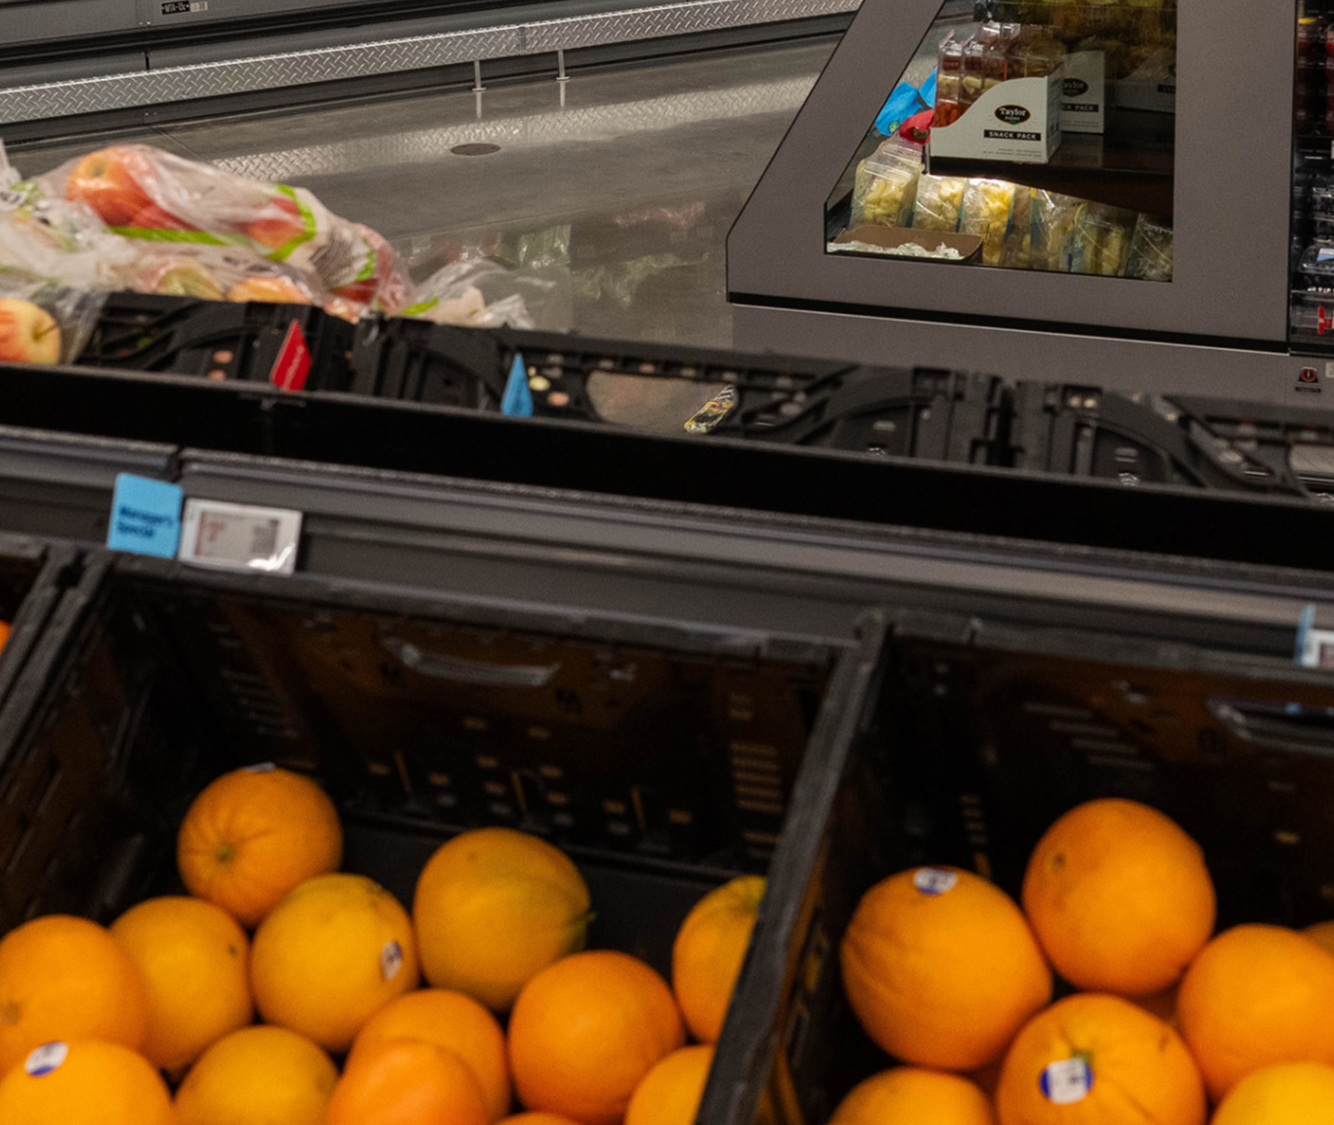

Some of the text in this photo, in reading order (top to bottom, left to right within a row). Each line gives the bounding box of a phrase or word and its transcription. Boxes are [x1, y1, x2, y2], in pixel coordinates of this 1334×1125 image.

[1063, 82, 1085, 92] aylor
[999, 107, 1027, 118] Taylor
[988, 131, 1037, 140] SNACK PACK
